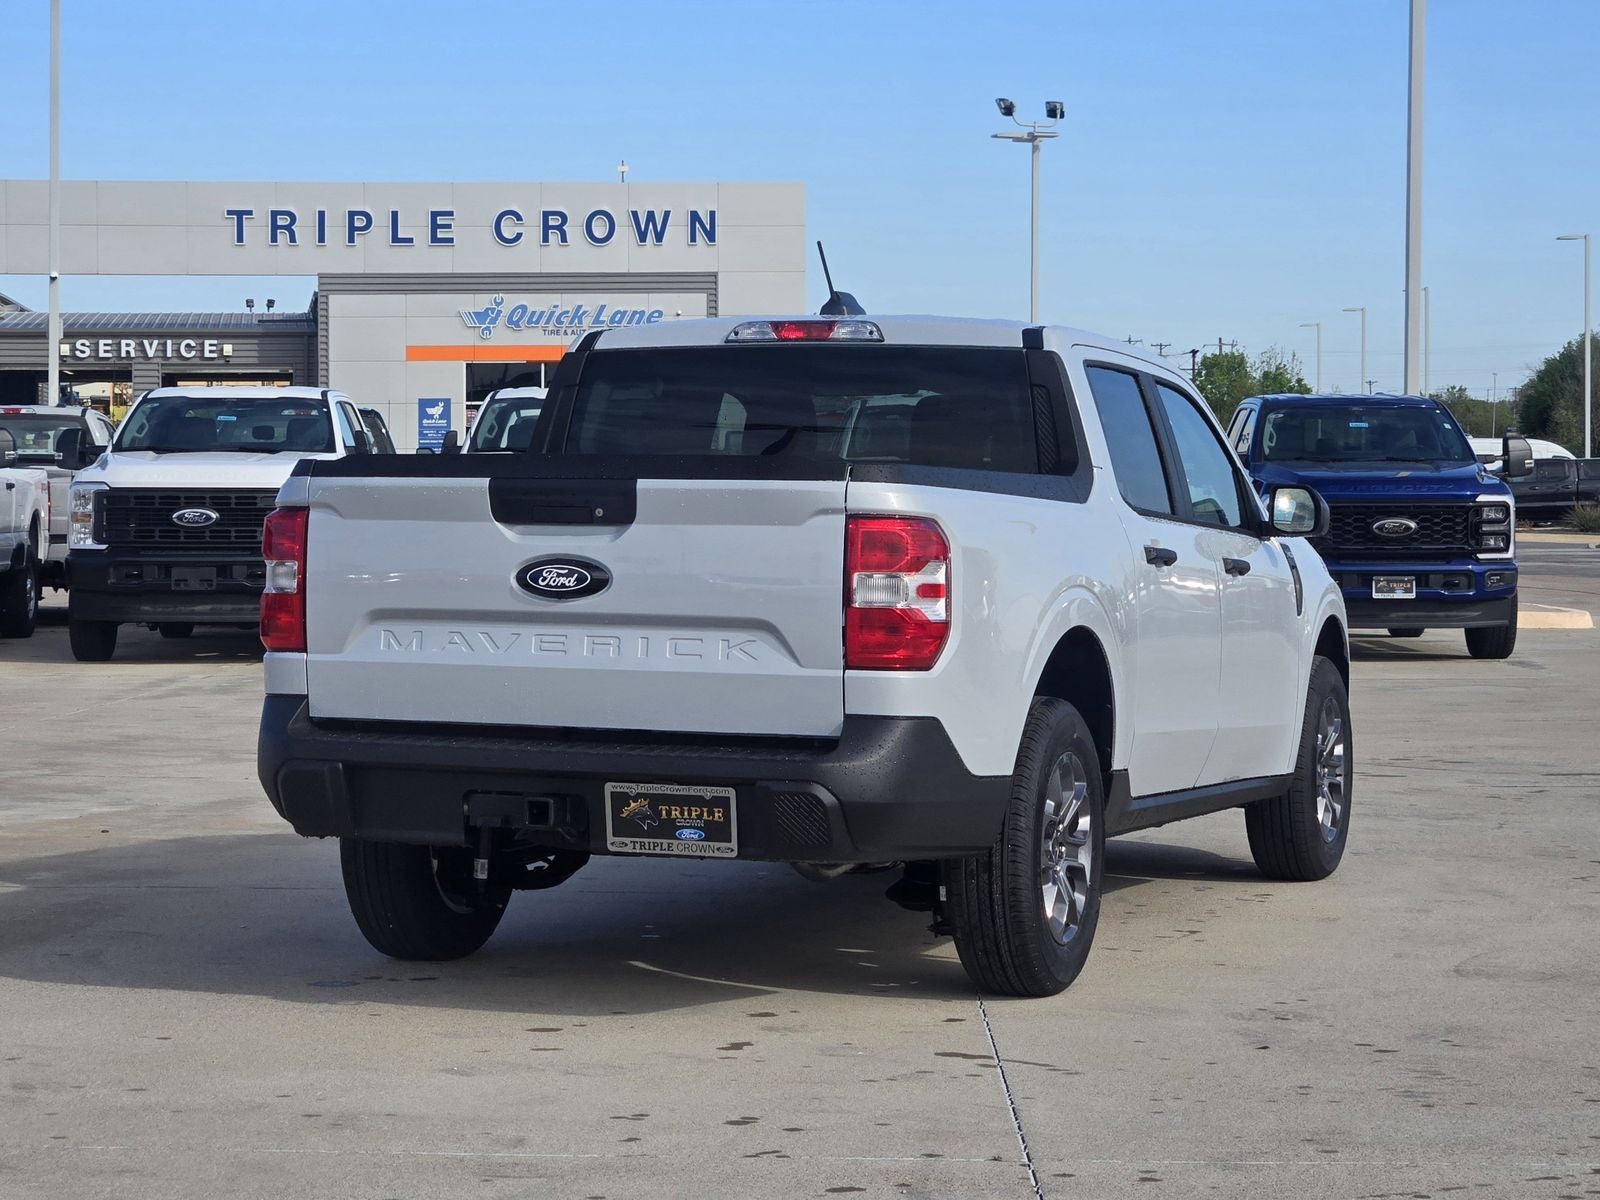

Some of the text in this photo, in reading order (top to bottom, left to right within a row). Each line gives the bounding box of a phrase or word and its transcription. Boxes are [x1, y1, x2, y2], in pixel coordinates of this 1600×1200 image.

[225, 208, 718, 247] TRIPLE CROWN
[506, 303, 664, 330] Quick Lane
[75, 339, 218, 358] SERVICE
[183, 512, 206, 522] Ford
[1383, 522, 1406, 533] Ford
[538, 568, 578, 587] Ford
[379, 628, 759, 662] MAVERICK
[659, 805, 724, 821] TRIPLE
[676, 819, 704, 827] CROWN
[630, 840, 674, 851] TRIPLE
[676, 843, 715, 853] CROWN
